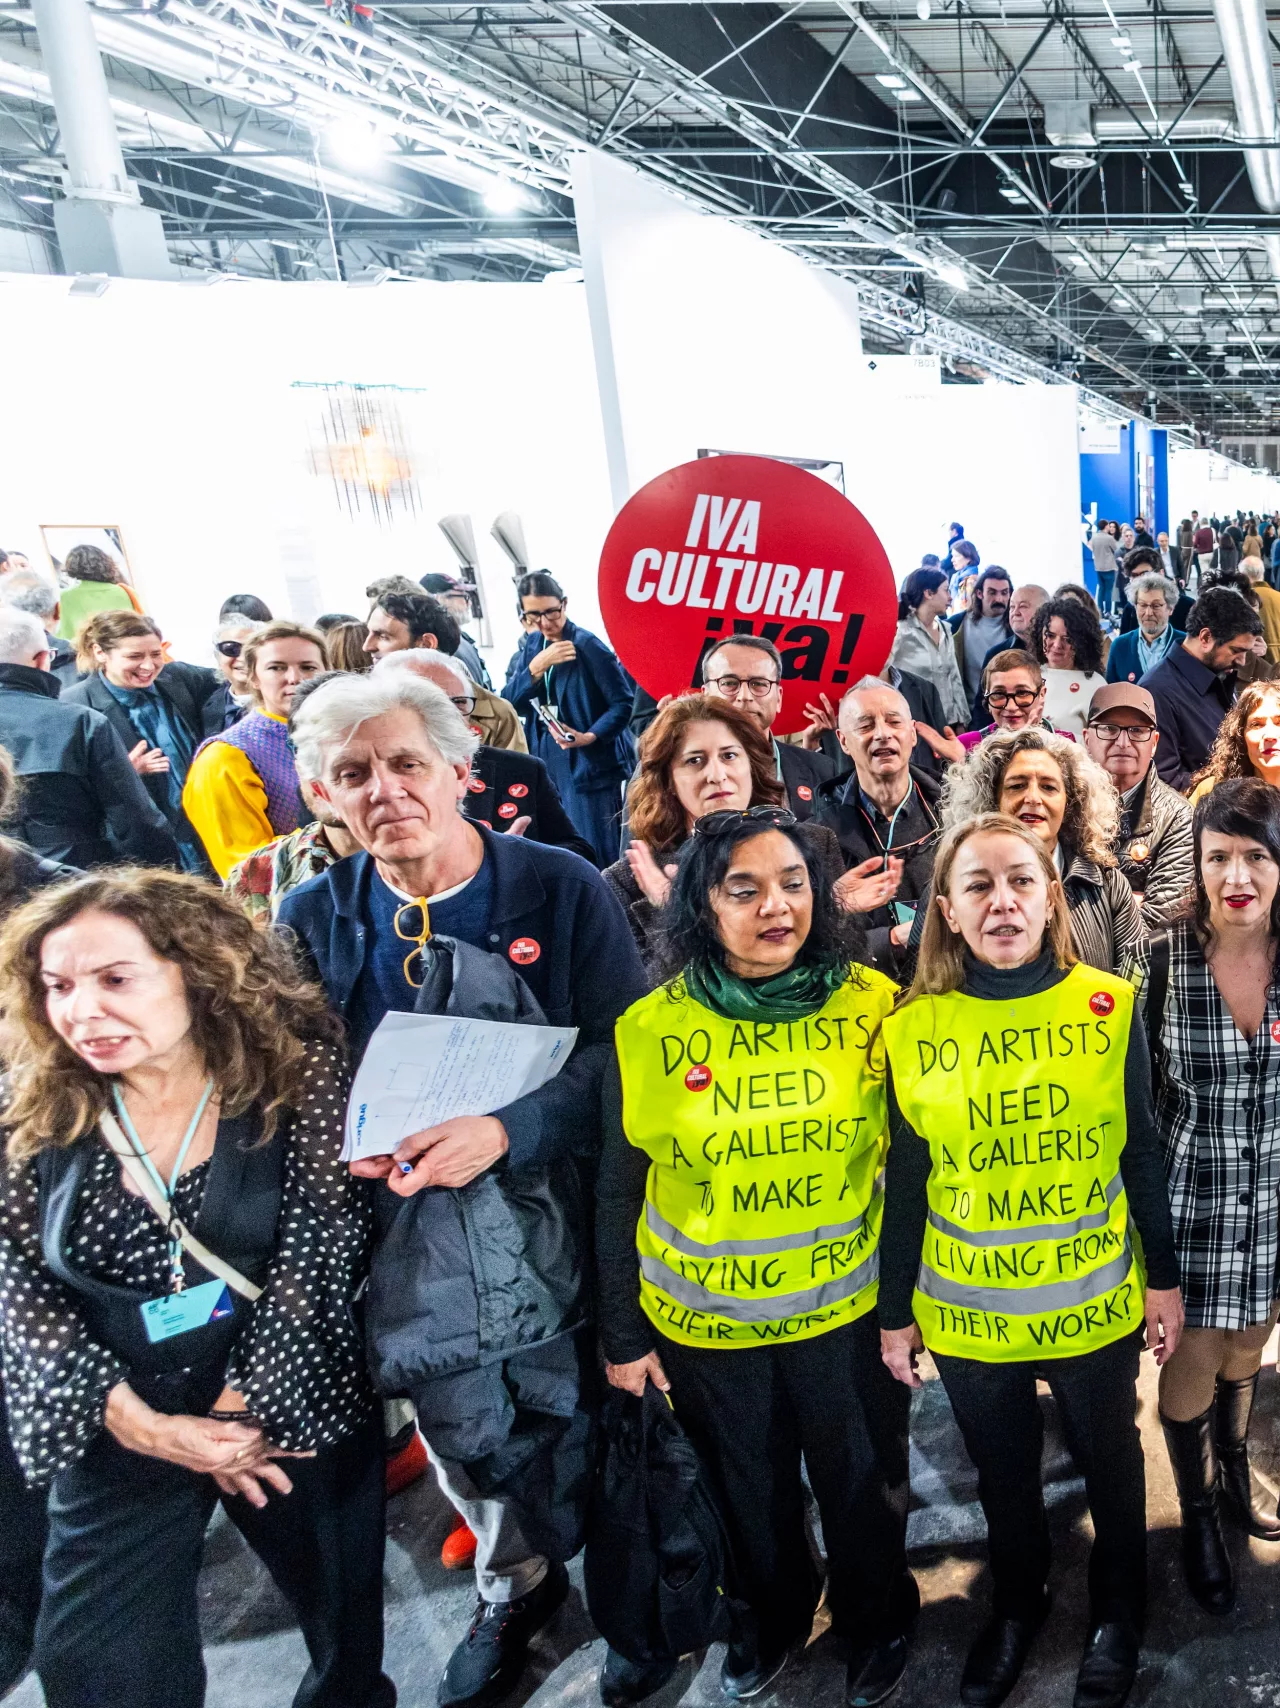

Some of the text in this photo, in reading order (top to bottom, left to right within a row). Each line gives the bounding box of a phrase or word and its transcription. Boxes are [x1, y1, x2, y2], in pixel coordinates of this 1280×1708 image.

[685, 494, 761, 555] IVA
[625, 548, 844, 622] CULTURAL
[661, 1029, 711, 1077] DO
[917, 1038, 959, 1076] DO
[714, 1068, 825, 1116] NEED
[968, 1083, 1070, 1131] NEED
[673, 1137, 693, 1170] A
[942, 1143, 959, 1173] A
[733, 1173, 823, 1213] MAKE
[944, 1177, 1106, 1222] TO MAKE A
[1056, 1228, 1121, 1273] FROM
[1027, 1283, 1132, 1346] WORK?
